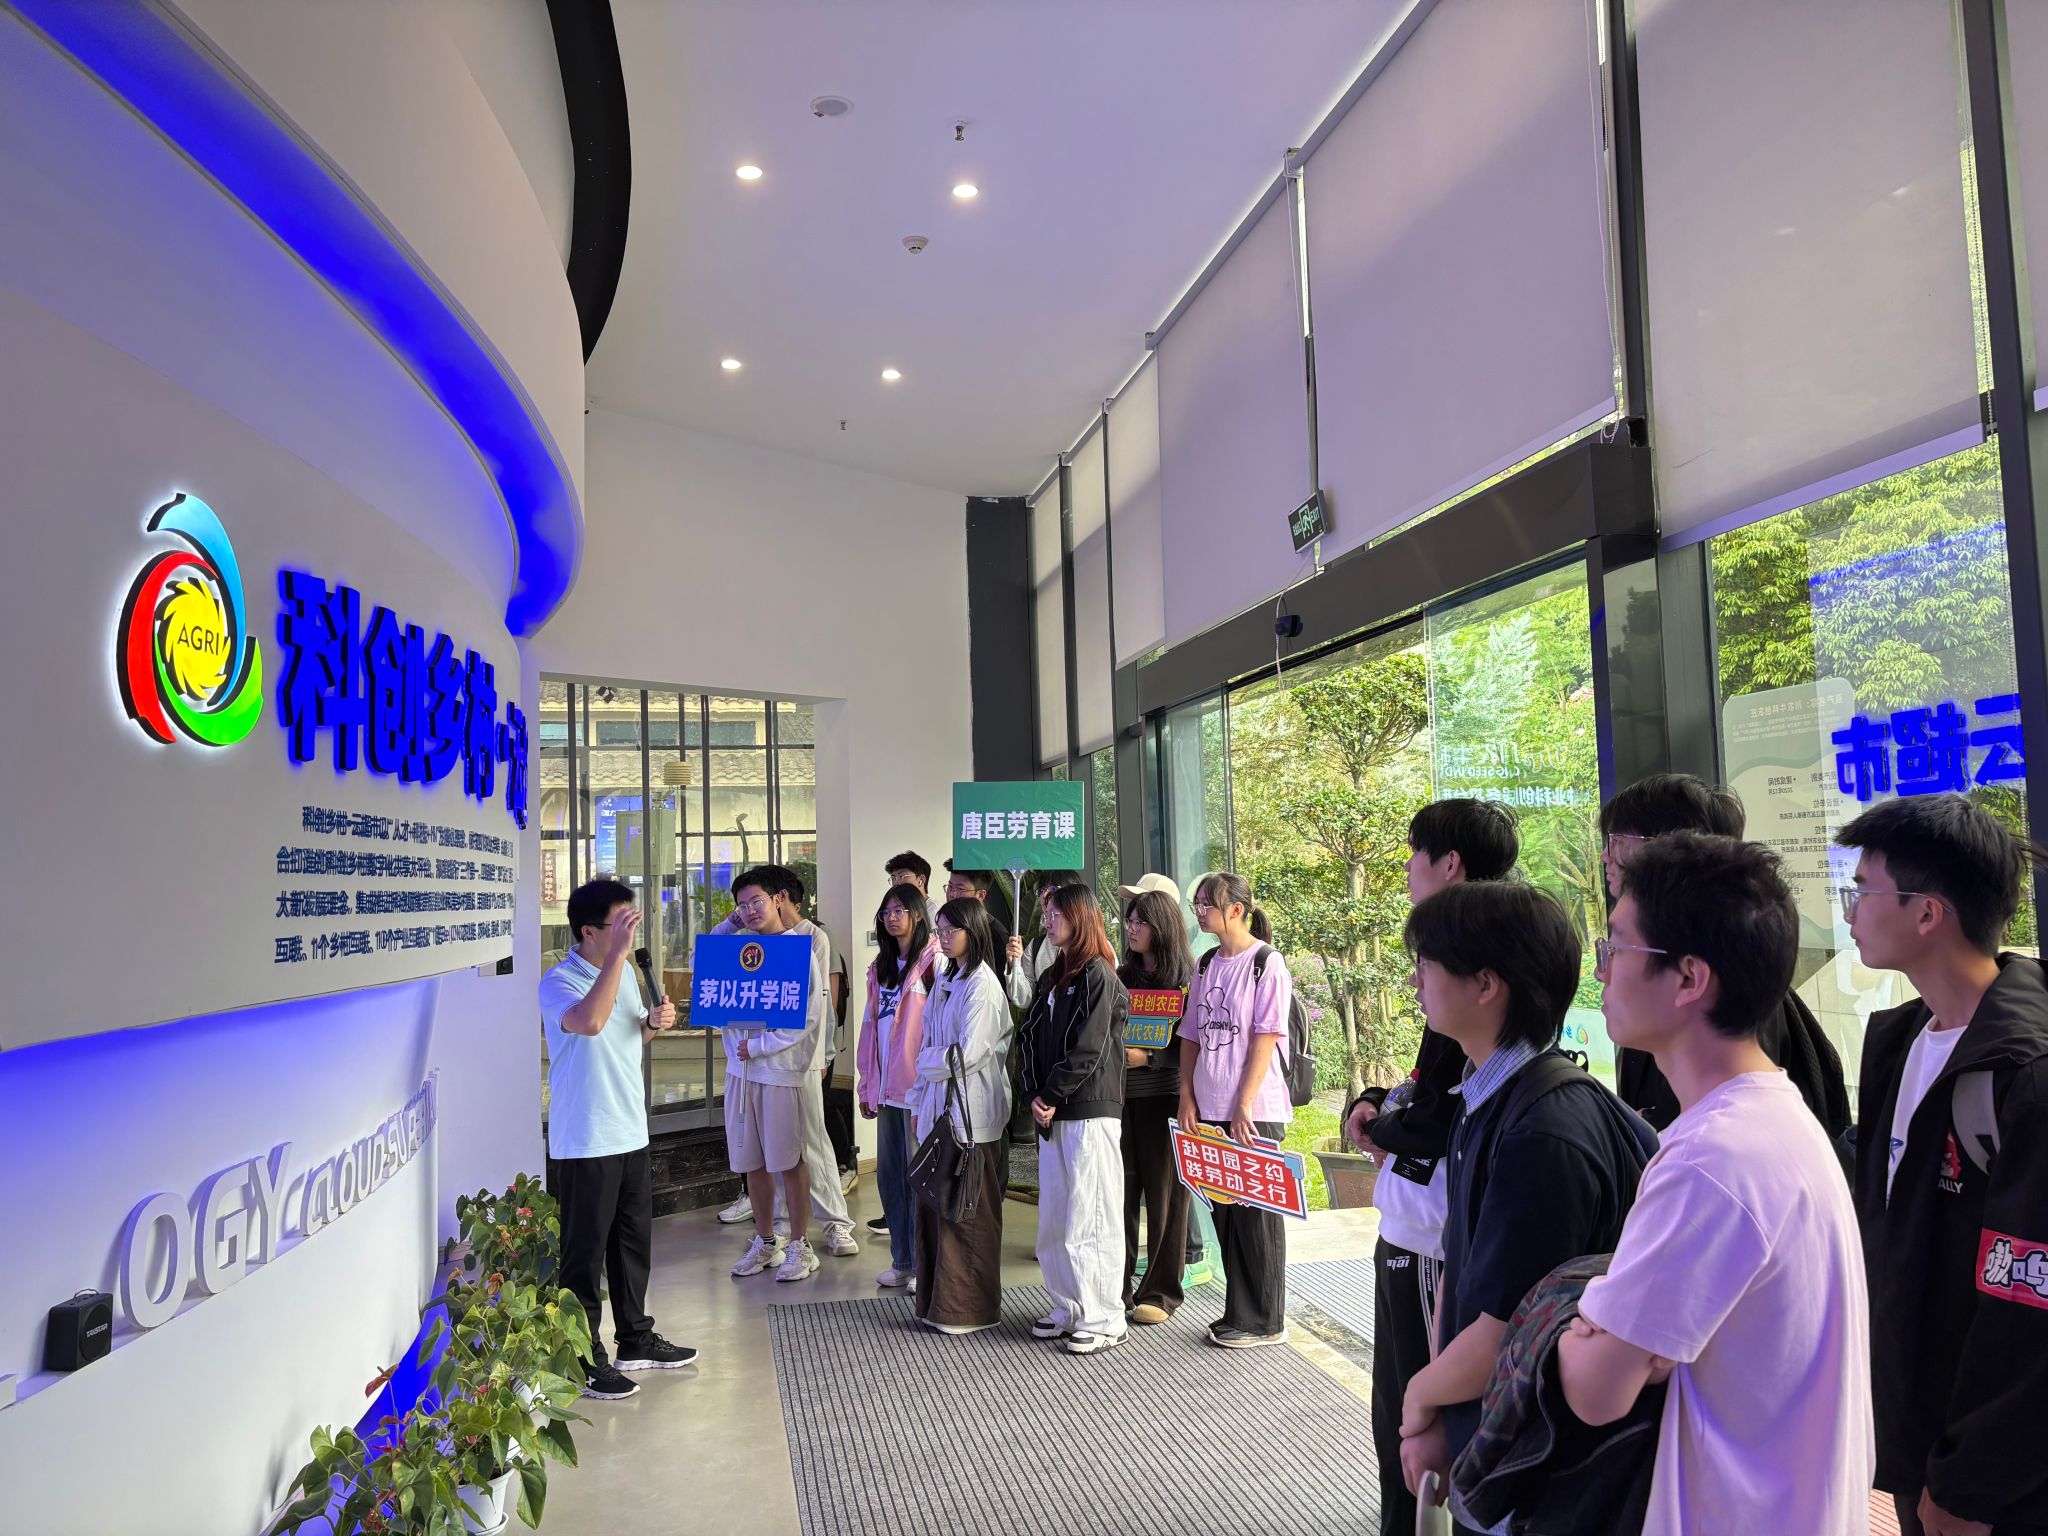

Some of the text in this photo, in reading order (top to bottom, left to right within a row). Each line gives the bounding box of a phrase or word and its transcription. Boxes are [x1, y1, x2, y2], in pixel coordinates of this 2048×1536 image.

[177, 625, 221, 656] AGRI
[961, 811, 1076, 840] 唐臣劳育课
[699, 977, 801, 1012] 茅以升学院
[1130, 993, 1180, 1013] 科创农庄
[1181, 1139, 1284, 1184] 赴田园之约
[1185, 1159, 1287, 1205] 践劳动之行
